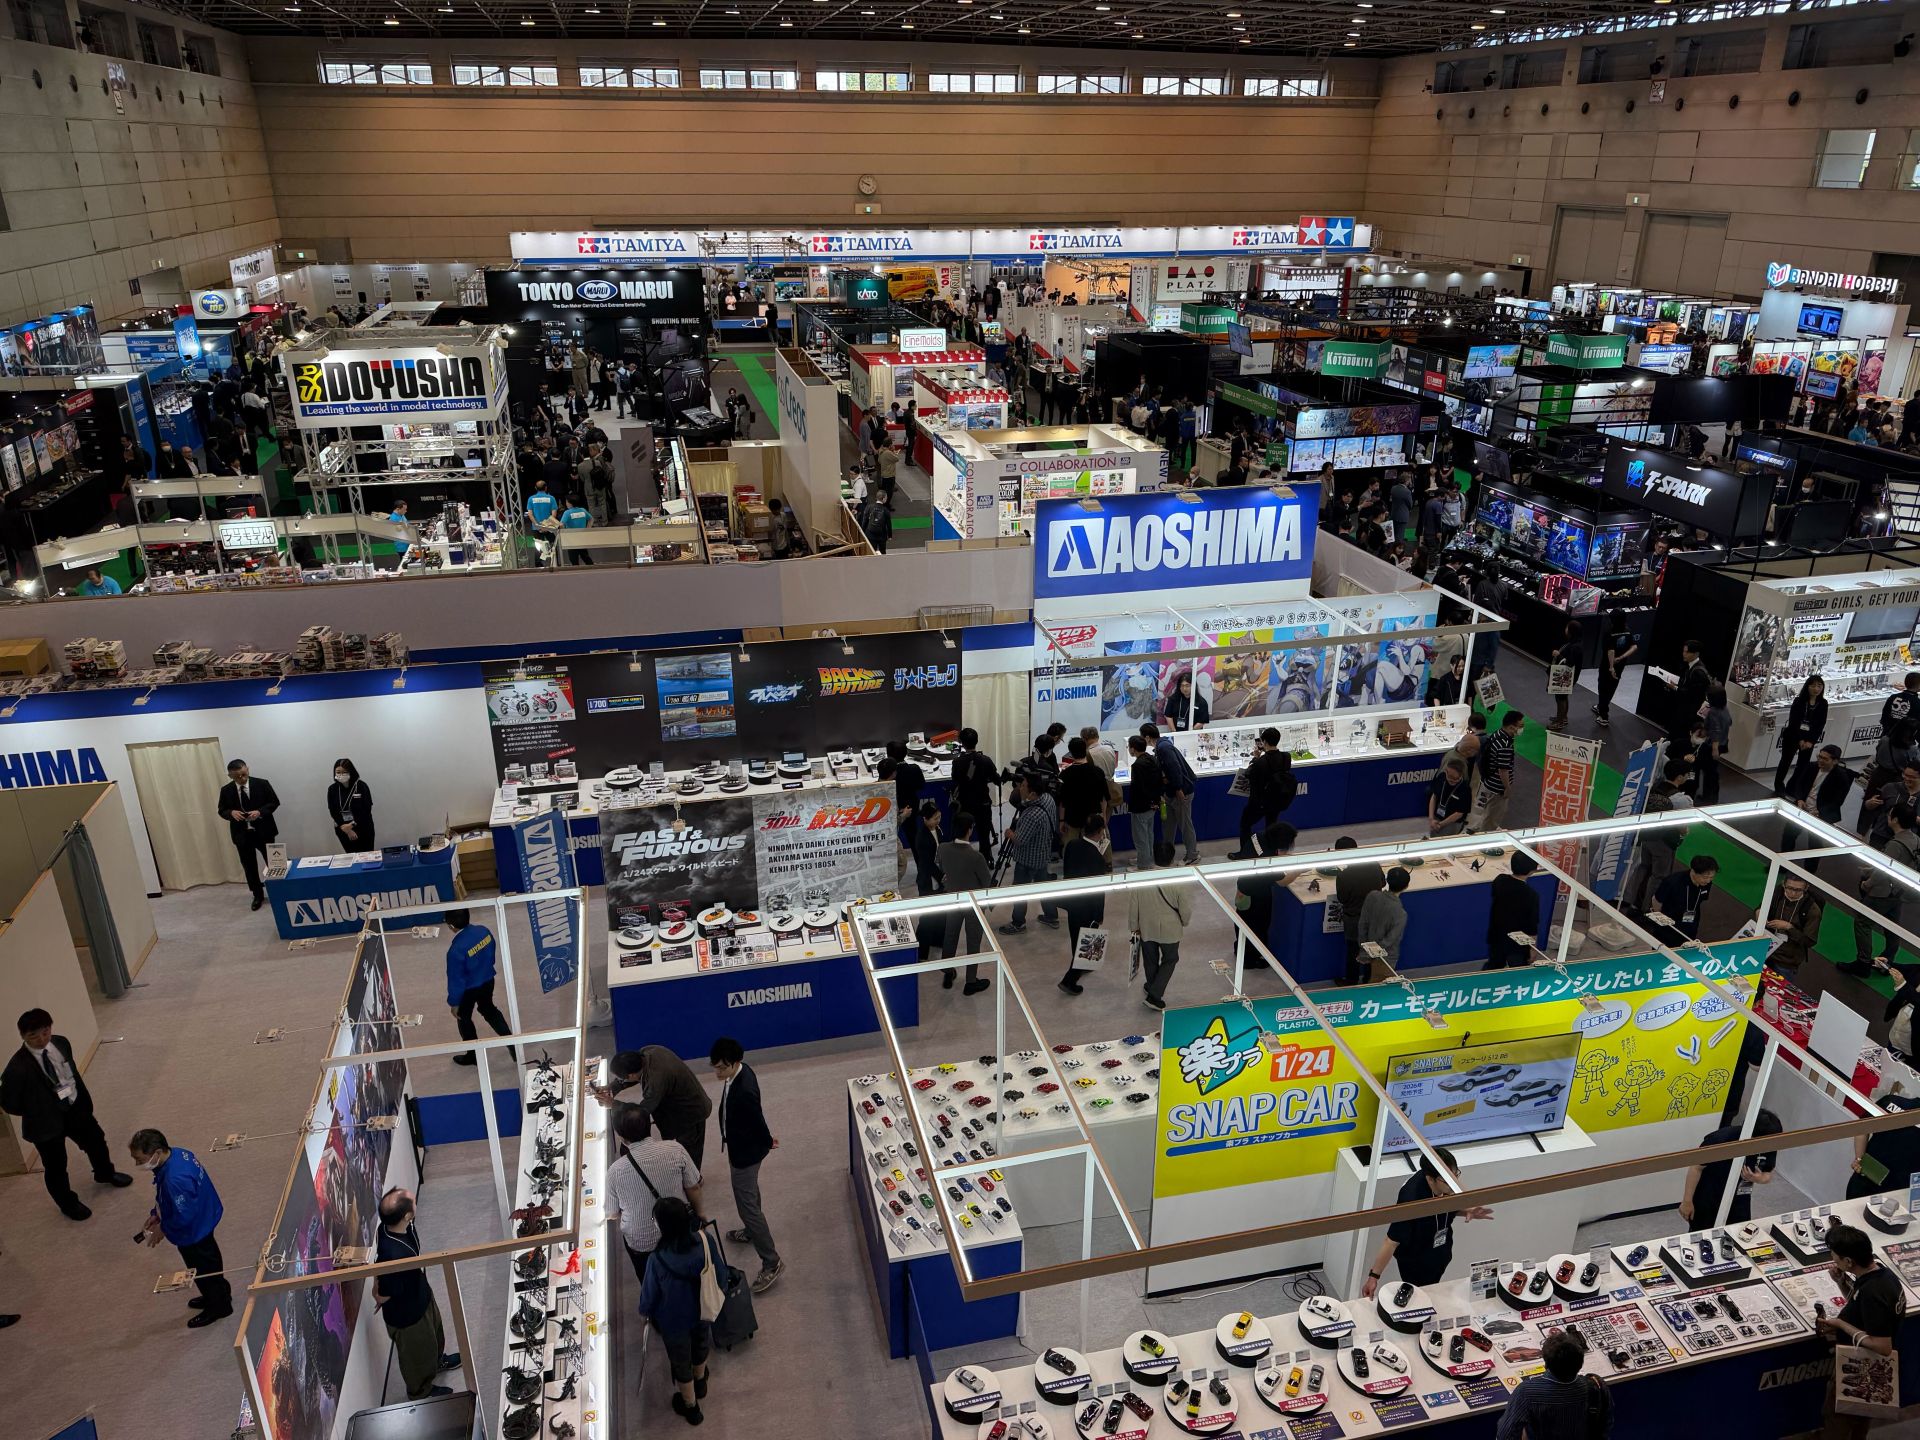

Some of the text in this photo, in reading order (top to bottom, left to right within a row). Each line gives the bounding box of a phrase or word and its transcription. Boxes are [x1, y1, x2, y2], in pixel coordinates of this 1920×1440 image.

[612, 238, 687, 252] TAMIYA
[845, 237, 913, 251] TAMIYA
[1059, 235, 1122, 248] TAMIYA
[1167, 281, 1214, 289] PLATZ
[1788, 268, 1898, 294] BANDAI HOBBY
[518, 282, 574, 302] TOKYO
[620, 281, 674, 300] MARUI
[857, 288, 879, 300] KATO
[1326, 352, 1373, 367] KOTOBUKIYA
[1583, 346, 1622, 359] KOTOBUKIYA
[324, 357, 486, 402] DOYUSHA
[306, 400, 484, 415] Leading the world in model technology.
[1020, 457, 1117, 472] COLLABORATION
[1643, 471, 1712, 506] T-SPARK
[966, 461, 974, 539] COLLABORATION
[1102, 504, 1301, 574] AOSHIMA
[1831, 595, 1864, 610] GIRLS,
[1869, 593, 1890, 606] GET
[818, 667, 873, 683] BACK
[832, 678, 884, 694] FUTURE
[0, 747, 108, 789] HIMA
[612, 826, 694, 853] FAST
[768, 833, 886, 853] NINOMIYA DAIKI EK9 CIVIC TYPE R
[620, 835, 746, 866] FURIOUS
[768, 853, 801, 864] AKIYAMA
[802, 850, 832, 860] WATARU
[853, 845, 873, 855] LEVIN
[623, 865, 676, 878] 1/24スケール
[769, 860, 836, 874] KENJI RPS13 180SX
[320, 885, 440, 924] AOSHIMA
[745, 982, 812, 1006] AOSHIMA
[1359, 967, 1653, 1019] カーモデルにチャレンジしたい
[1278, 1019, 1313, 1030] PLASTIC
[1179, 1035, 1263, 1085] 楽プラ
[1275, 1051, 1330, 1079] 1/24
[1166, 1082, 1360, 1143] SNAP CAR
[1252, 1131, 1298, 1144] スナップカー
